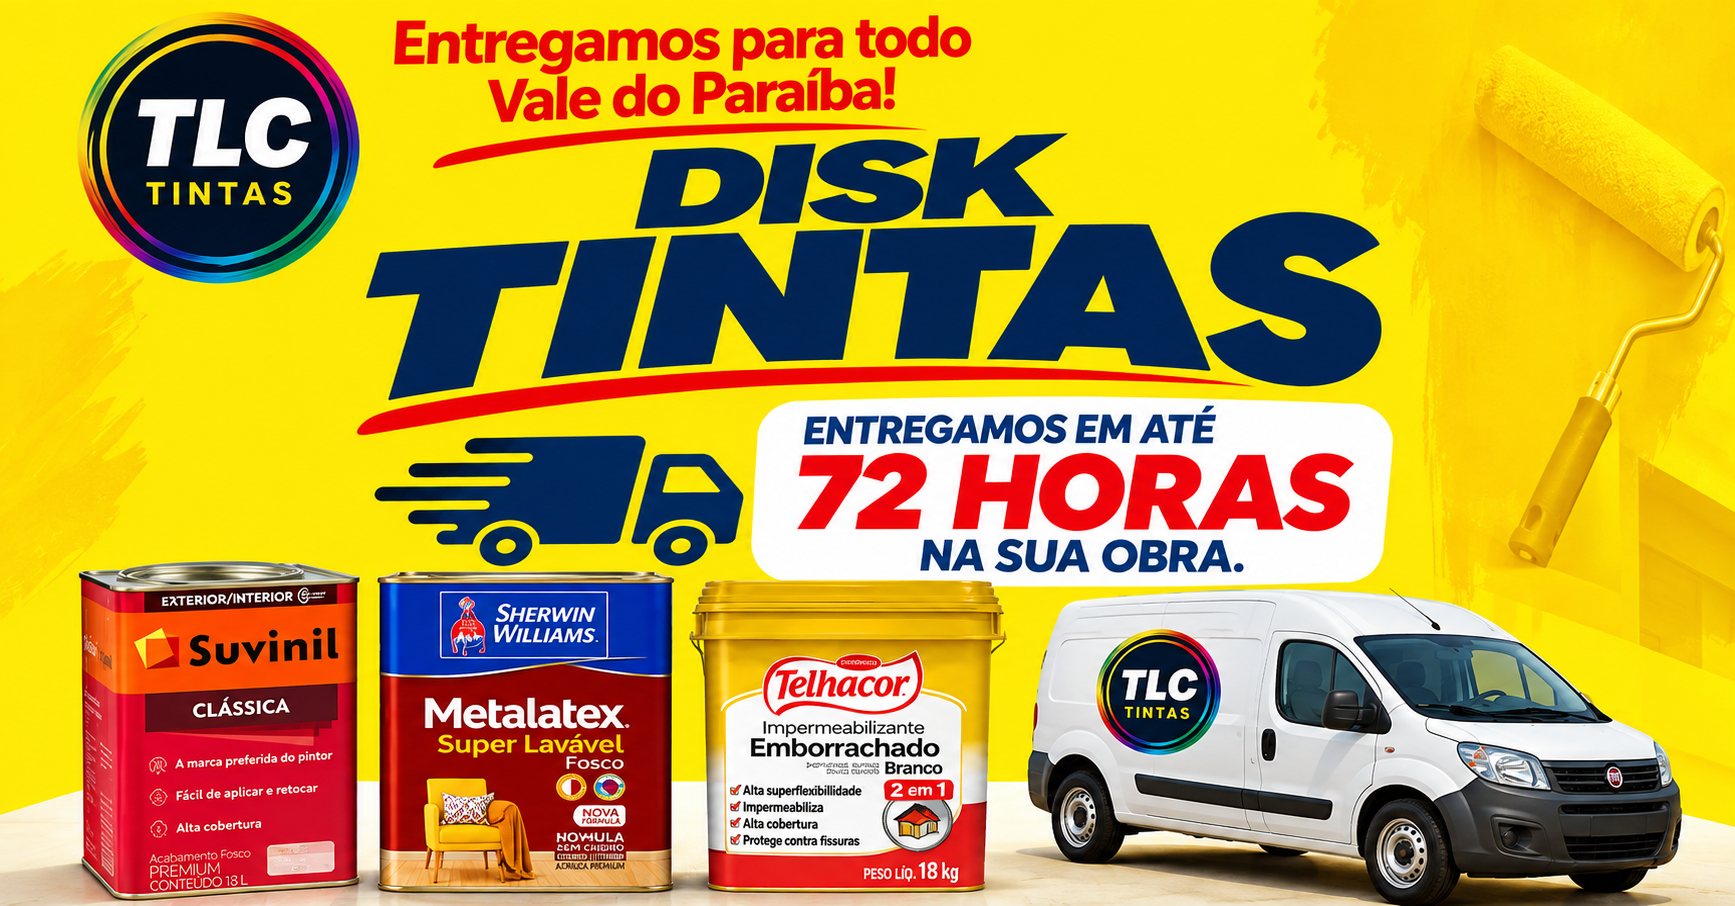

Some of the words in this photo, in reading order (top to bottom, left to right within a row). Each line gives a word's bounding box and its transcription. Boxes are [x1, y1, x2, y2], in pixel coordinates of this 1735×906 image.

[394, 20, 720, 75] Entregamos
[732, 27, 844, 72] para
[856, 15, 971, 58] todo
[488, 76, 600, 123] Vale
[613, 74, 680, 117] do
[693, 67, 896, 115] Paraíba!
[138, 98, 311, 167] TLC
[635, 133, 1068, 229] DISK
[147, 182, 291, 205] TINTAS
[366, 212, 1382, 400] TINTAS
[804, 414, 1067, 444] ENTREGAMOS
[1076, 415, 1131, 443] EM
[1140, 406, 1216, 443] ATÉ
[798, 453, 927, 529] 72
[953, 453, 1354, 531] HORAS
[921, 540, 980, 571] NA
[995, 539, 1084, 572] SUA
[1102, 540, 1243, 572] OBRA.
[161, 591, 293, 607] EXTERIOR/INTERIOR
[495, 603, 596, 623] SHERWIN
[190, 628, 338, 666] Suvinil
[1122, 669, 1198, 701] TLC
[193, 697, 289, 717] CLÁSSICA
[1125, 707, 1189, 719] TINTAS
[763, 720, 925, 738] Impermeabilizante
[438, 735, 517, 757] Super
[524, 733, 625, 754] Lavável
[750, 738, 940, 758] Emborrachado
[175, 758, 185, 769] A
[187, 758, 223, 768] marca
[225, 753, 278, 769] preferida
[280, 752, 296, 763] do
[298, 751, 333, 764] pintor
[567, 757, 623, 769] Fosco
[884, 761, 943, 775] Branco
[176, 789, 204, 801] Fácil
[206, 788, 222, 799] de
[223, 786, 264, 801] aplicar
[265, 787, 274, 796] e
[276, 784, 319, 795] retocar
[742, 784, 765, 796] Alta
[890, 782, 904, 798] 2
[908, 786, 933, 797] em
[936, 781, 946, 797] 1
[581, 807, 620, 818] NOVA
[743, 801, 824, 815] Impermeabiliza
[176, 822, 201, 833] Alta
[203, 820, 262, 832] cobertura
[742, 817, 764, 829] Alta
[766, 817, 818, 830] cobertura
[743, 834, 783, 849] Protege
[784, 835, 818, 846] contra
[819, 835, 860, 846] fissuras
[148, 850, 219, 865] Acabamento
[220, 848, 252, 860] Fosco
[148, 860, 221, 880] PREMIUM
[225, 874, 239, 887] 18
[240, 873, 249, 887] L
[863, 867, 892, 880] PESO
[919, 862, 937, 879] 18
[942, 862, 958, 883] kg
